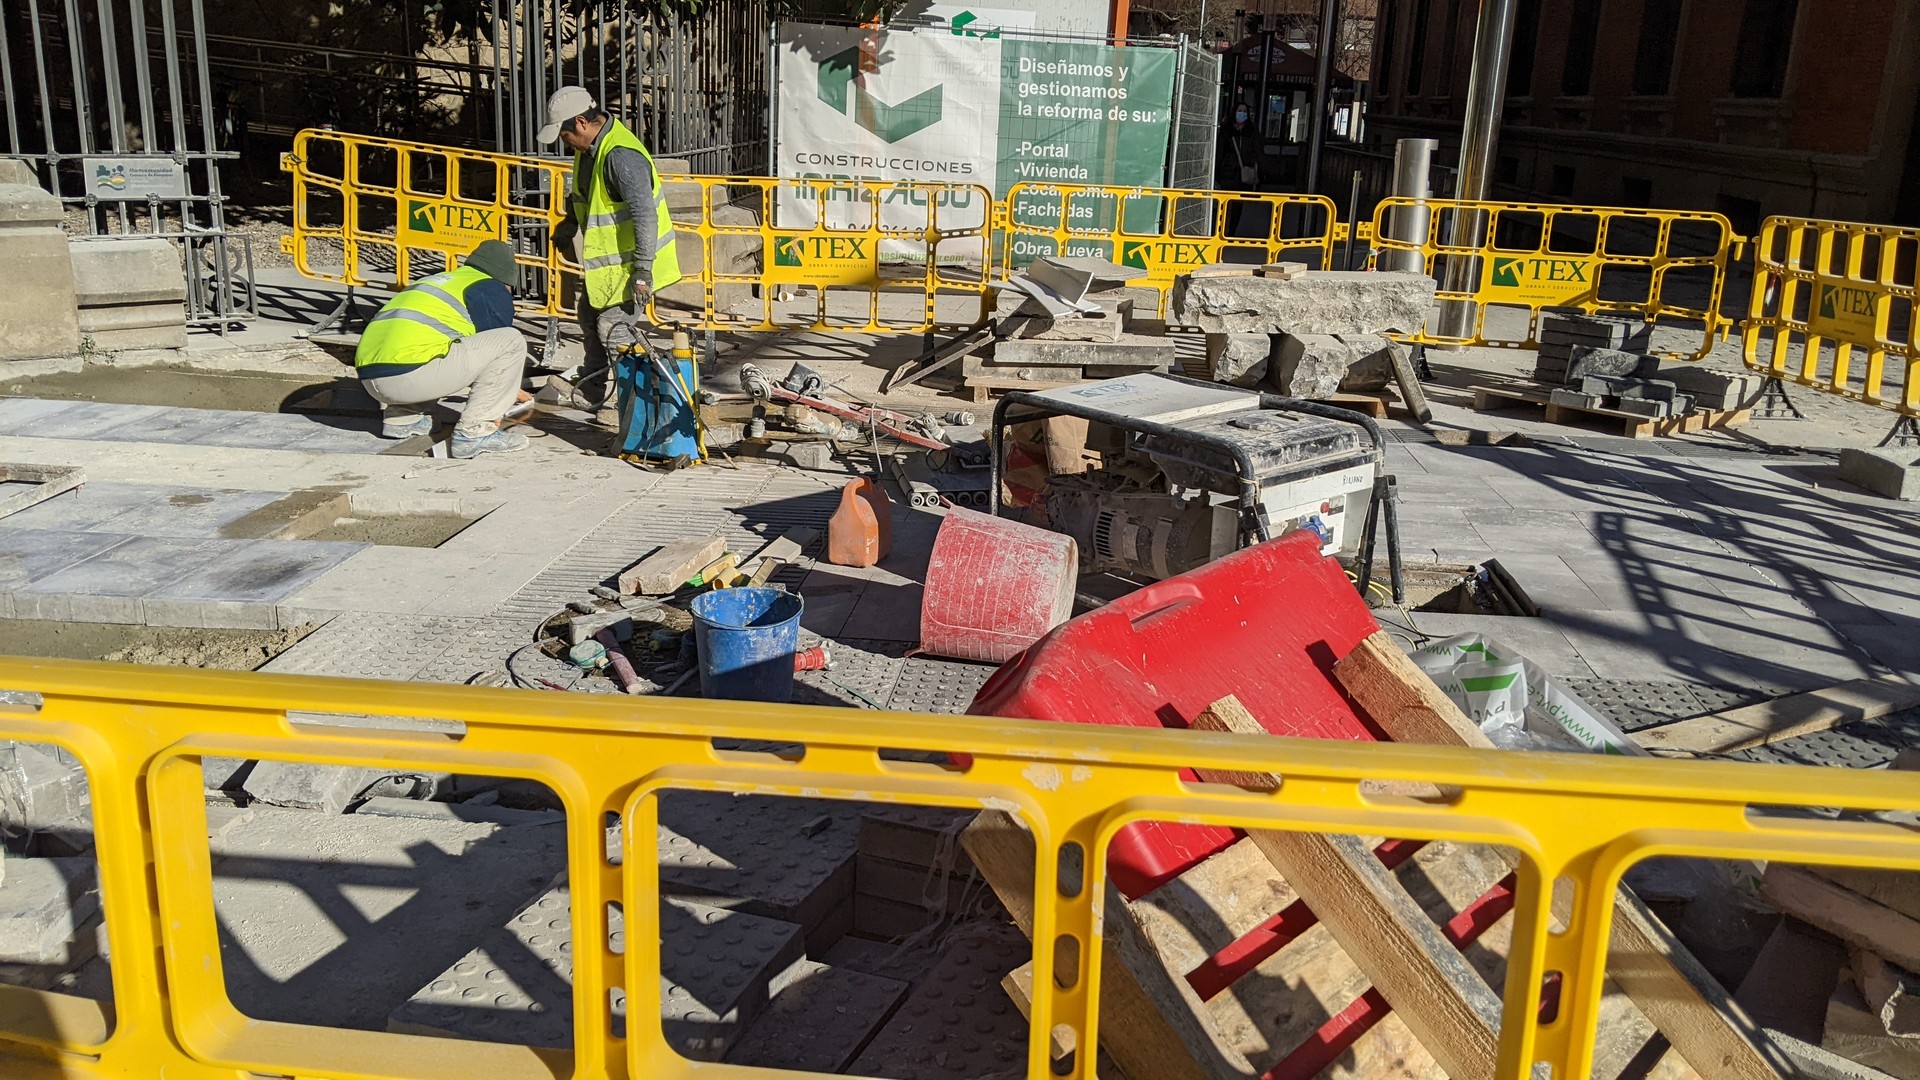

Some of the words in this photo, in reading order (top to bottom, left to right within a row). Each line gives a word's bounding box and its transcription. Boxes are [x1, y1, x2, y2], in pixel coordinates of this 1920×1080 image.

[1019, 57, 1113, 78] Diseñamos
[1118, 66, 1128, 81] y
[1018, 81, 1128, 99] gestionamos
[1017, 101, 1032, 116] la
[1037, 103, 1103, 120] reforma
[1108, 106, 1128, 121] de
[1132, 110, 1157, 123] su:
[1015, 141, 1069, 158] -Portal
[795, 152, 973, 175] CONSTRUCCIONES
[1014, 162, 1088, 180] -Vivienda
[439, 204, 495, 233] TEX
[808, 236, 868, 260] TEX
[1059, 247, 1104, 259] ueva
[1155, 242, 1211, 265] TEX
[1528, 258, 1590, 283] TEX
[1841, 287, 1878, 317] TEX
[1526, 681, 1596, 746] www.pvt.e
